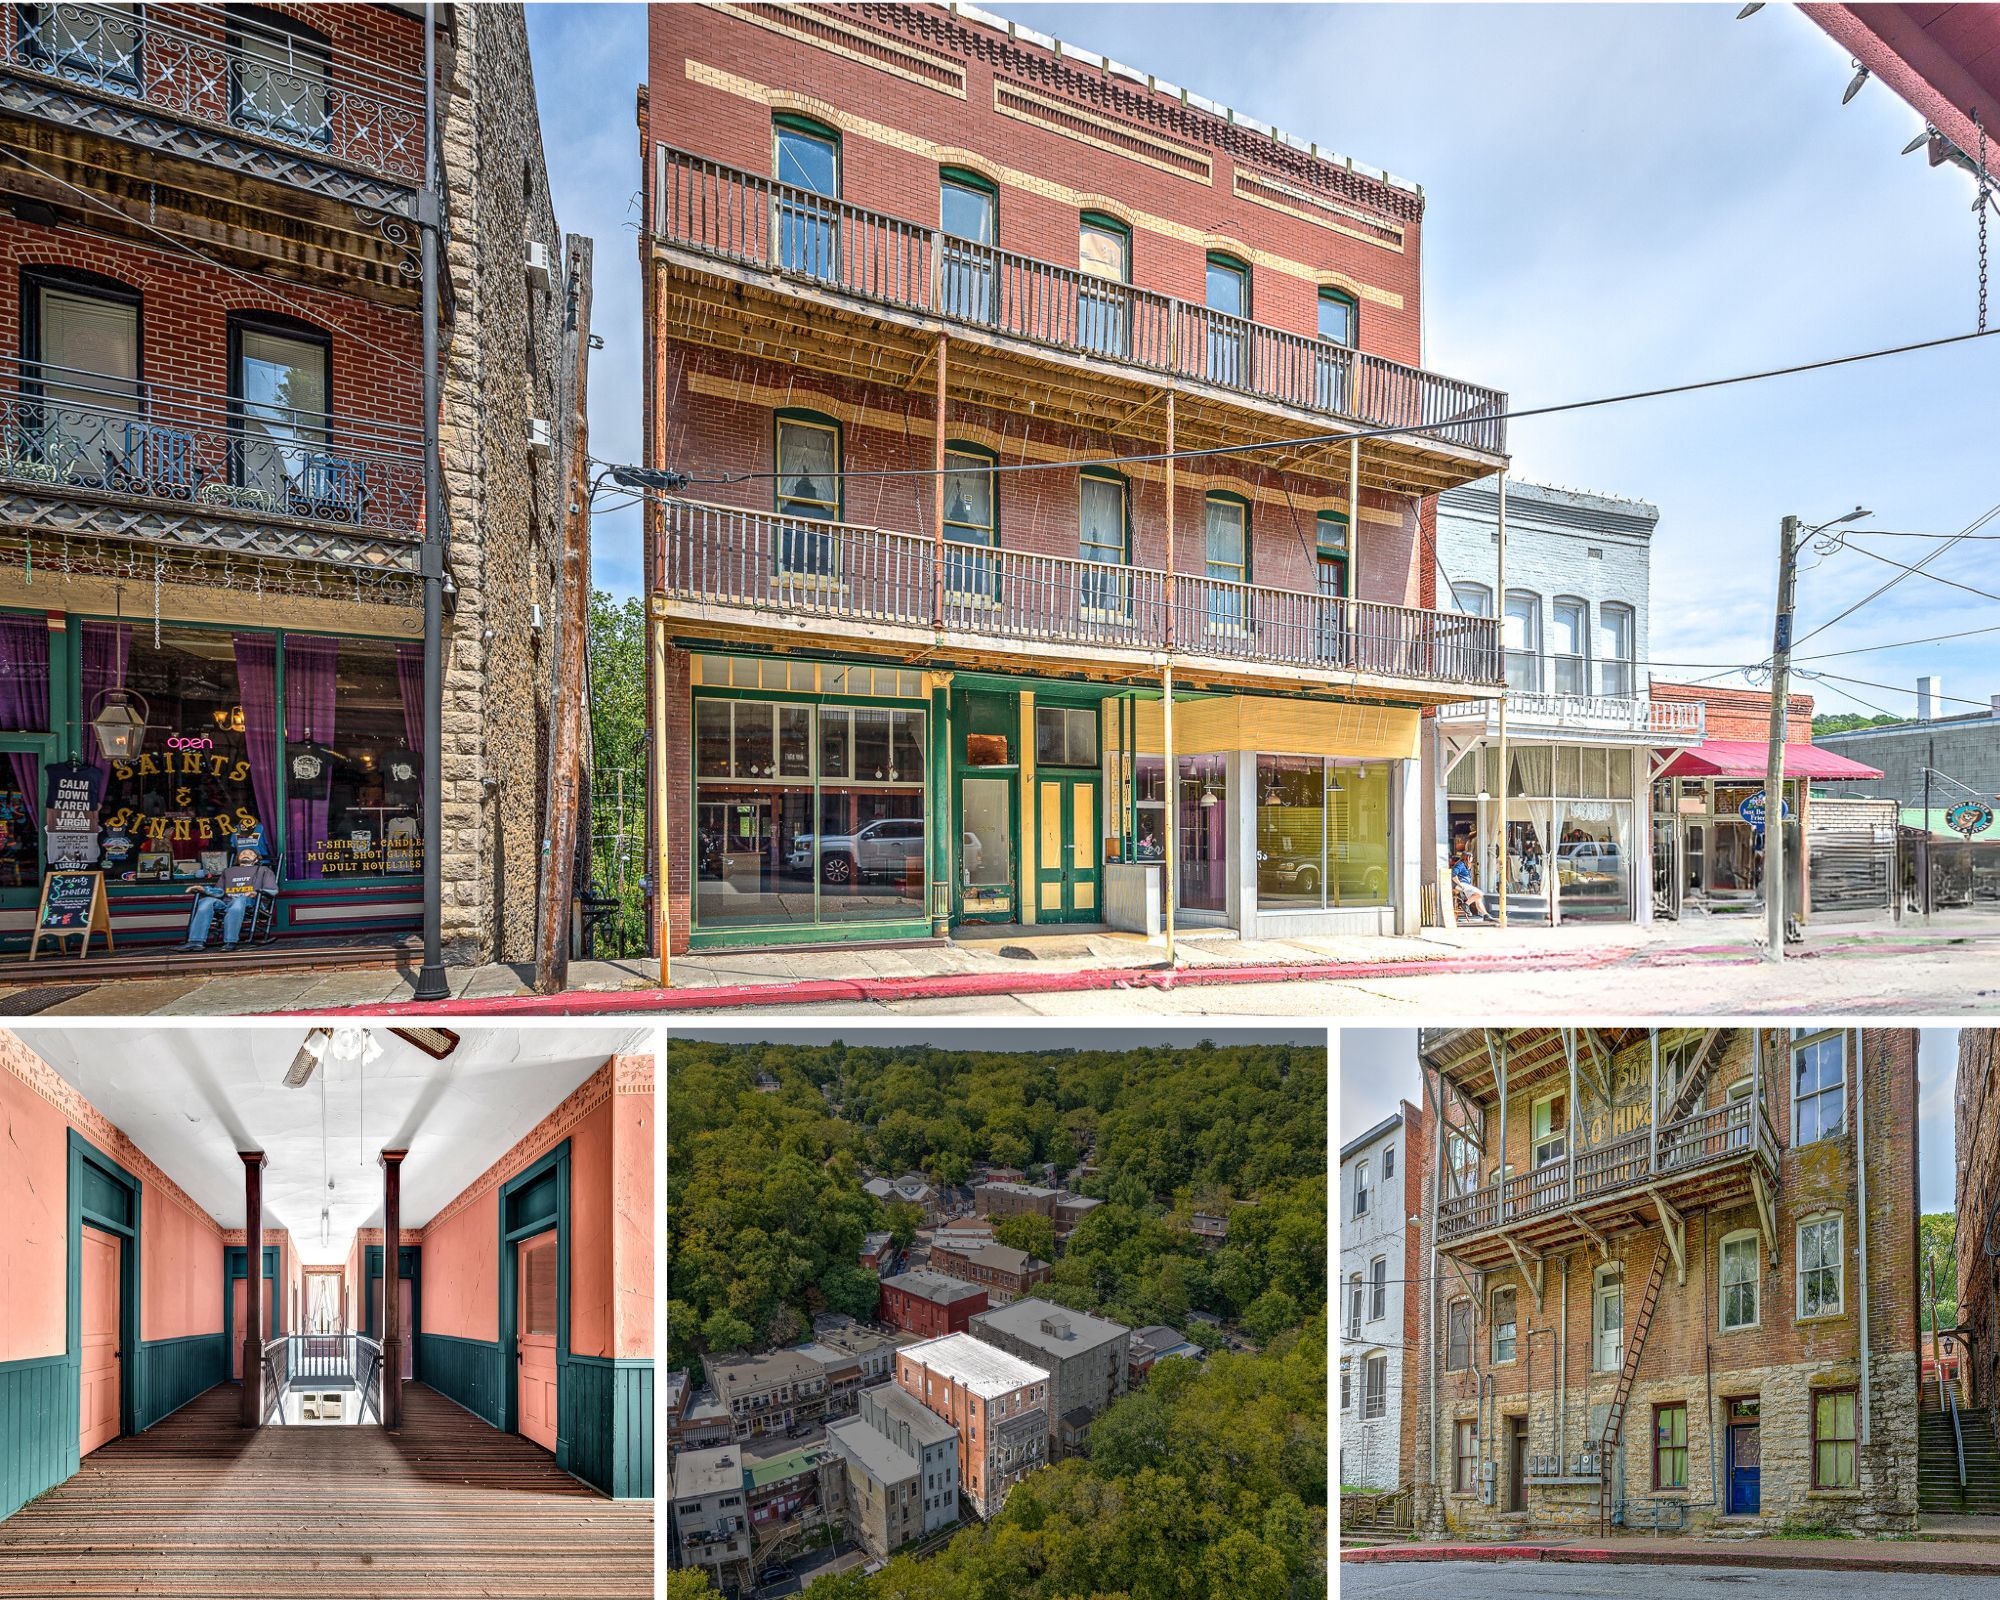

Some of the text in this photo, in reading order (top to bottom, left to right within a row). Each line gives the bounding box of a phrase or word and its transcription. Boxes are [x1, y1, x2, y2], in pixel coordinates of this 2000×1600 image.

[167, 737, 213, 750] open
[113, 752, 251, 782] SAINTS
[60, 779, 89, 790] CALM
[58, 790, 88, 800] DOWN
[55, 801, 90, 811] KAREN
[77, 811, 85, 819] A
[56, 818, 90, 827] VIRGIN
[104, 806, 257, 841] SINNERS
[316, 839, 369, 849] T-SHIRTS
[307, 852, 340, 861] MUGS
[353, 850, 382, 860] SHOT
[321, 860, 421, 872] ADULT NOVELTIES
